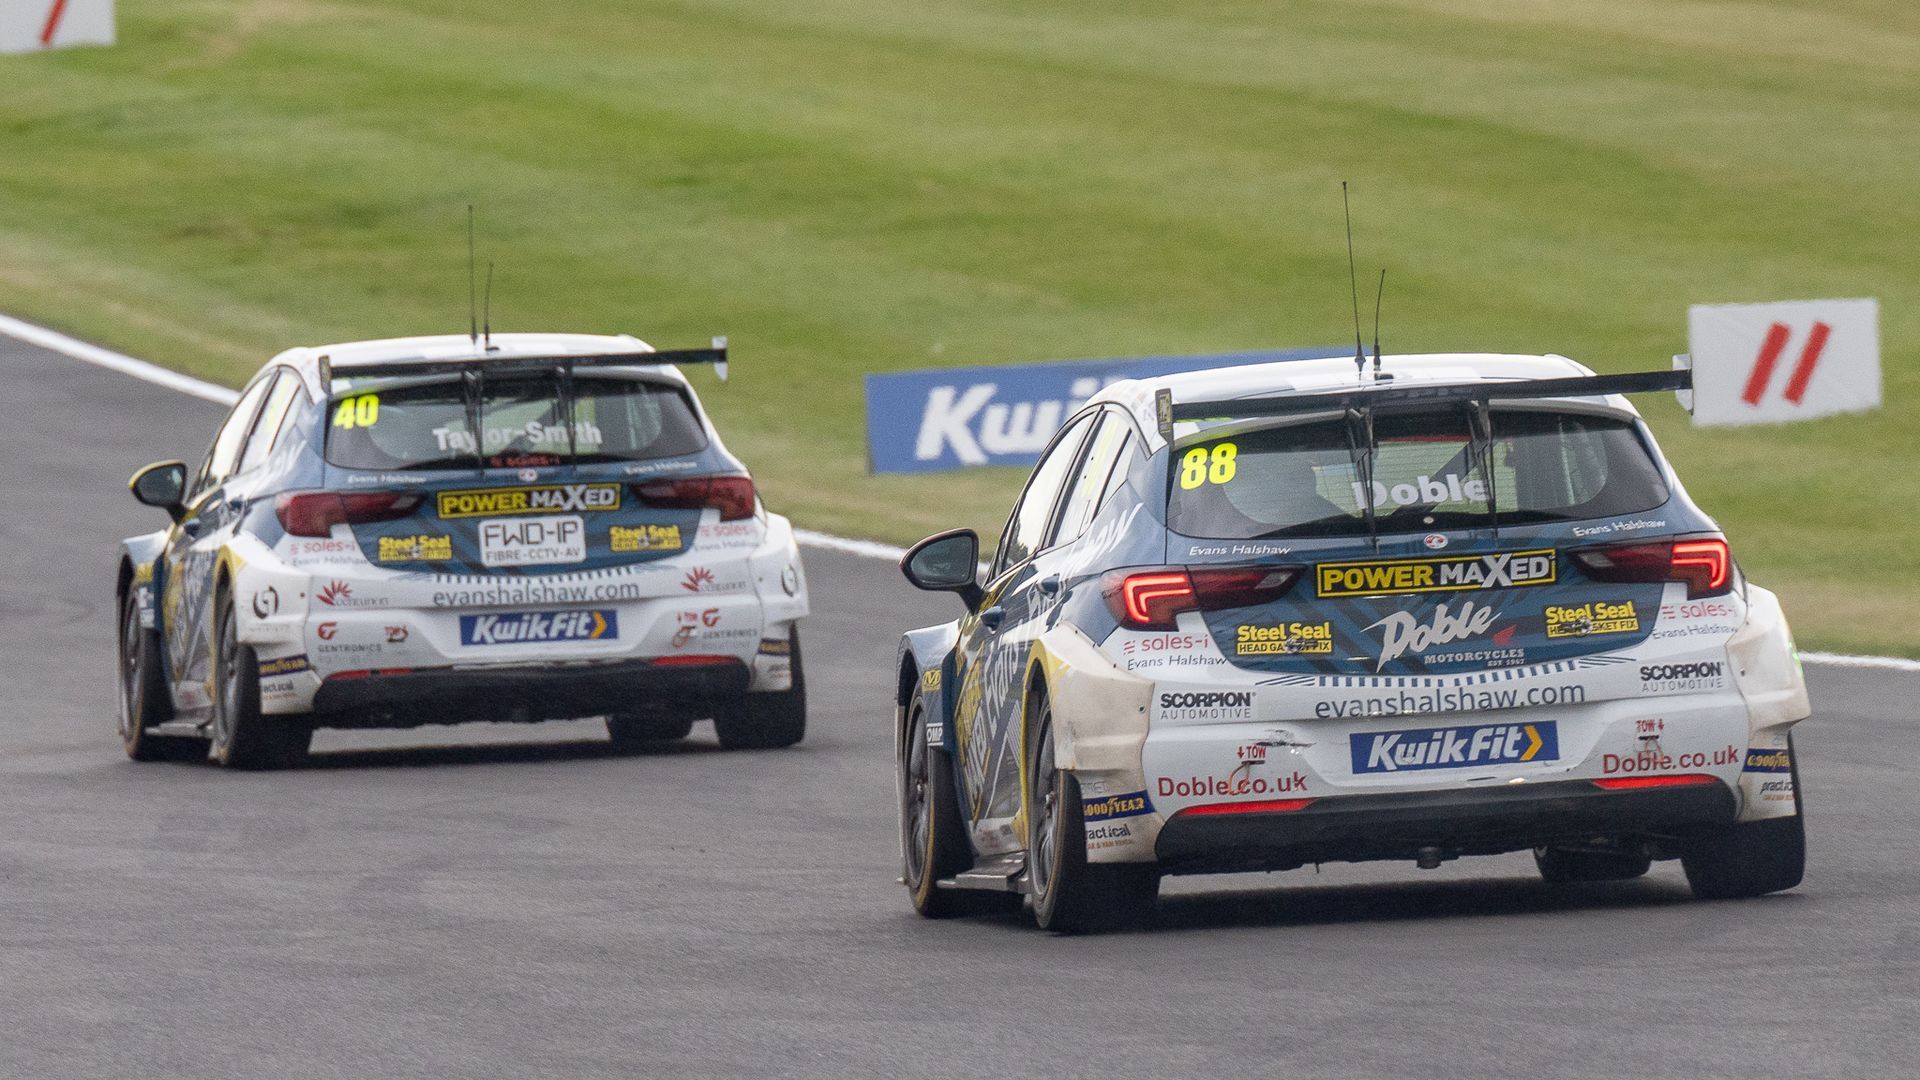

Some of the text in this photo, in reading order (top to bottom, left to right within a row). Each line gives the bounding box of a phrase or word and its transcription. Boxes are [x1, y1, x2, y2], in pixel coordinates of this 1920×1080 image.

[334, 394, 379, 430] 40
[433, 420, 604, 459] Tayor-Smth
[1180, 442, 1237, 490] 88
[442, 484, 616, 515] POWER MAXED
[1352, 472, 1489, 511] Doble
[484, 520, 579, 547] FWD-IP
[1573, 518, 1666, 538] Evans Halshaw
[303, 539, 356, 553] sales-i
[379, 534, 450, 549] Steel Seal
[1189, 544, 1292, 557] Evans Halshaw
[1323, 553, 1550, 591] POWER MAXED
[433, 583, 640, 606] evanshalshaw.com
[1545, 600, 1637, 624] Steel Seal
[472, 613, 592, 645] KwikFit
[1237, 621, 1332, 642] Steel Seal
[1620, 619, 1637, 629] FIX
[1653, 625, 1739, 640] Evans Halshaw
[1142, 633, 1209, 652] sales-i
[1360, 600, 1502, 673] Doble
[1239, 643, 1268, 653] HEAD
[1424, 648, 1525, 664] MOTORCYCLES
[1127, 654, 1228, 671] Evans Halshaw
[1640, 662, 1723, 682] SCORPION
[1641, 677, 1724, 692] AUTOMOTIVE
[1160, 691, 1251, 709] SCORPION
[1315, 683, 1586, 719] evanshalshaw.com
[1160, 707, 1252, 720] AUTOMOTIVE
[926, 728, 944, 742] OMP
[1636, 720, 1655, 732] TOW
[1247, 746, 1266, 758] TOW
[1367, 724, 1524, 772] KwikFit
[1603, 746, 1739, 773] Doble.co.uk
[1158, 772, 1307, 797] Doble.co.uk
